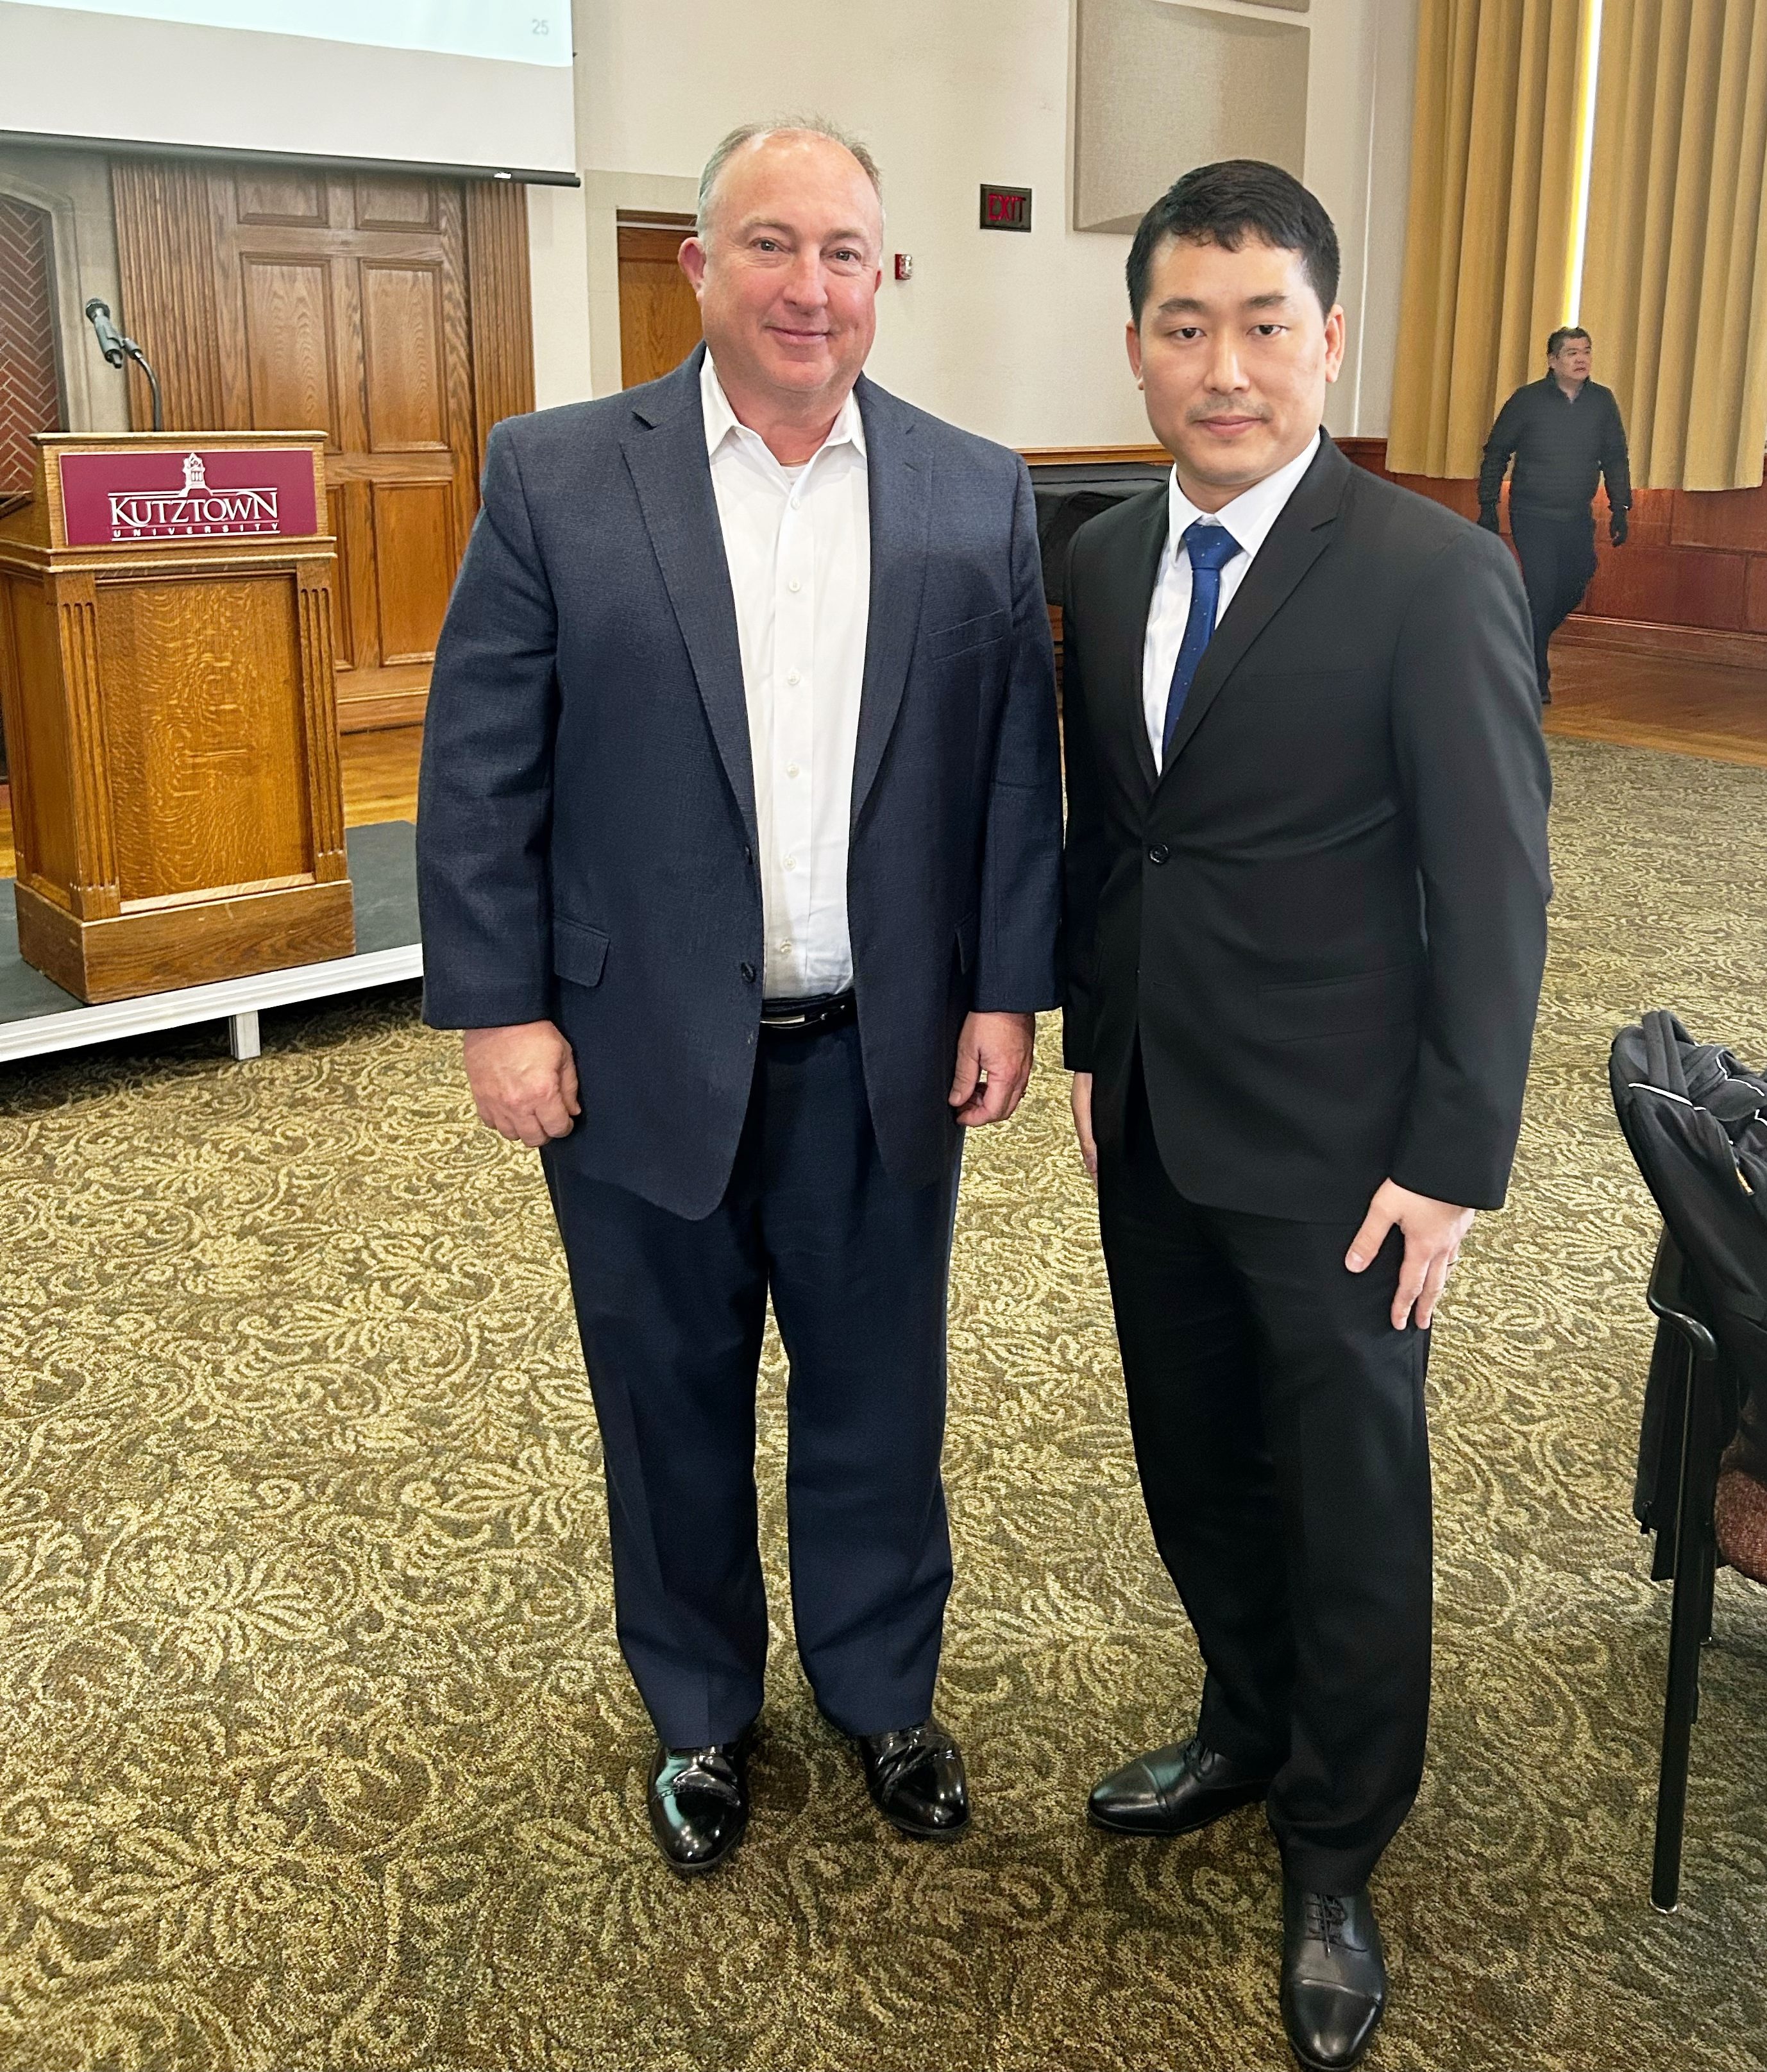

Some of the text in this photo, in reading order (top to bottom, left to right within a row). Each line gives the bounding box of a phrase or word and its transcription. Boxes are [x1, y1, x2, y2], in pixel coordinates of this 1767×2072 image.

[532, 19, 549, 35] 25
[988, 193, 1026, 222] EXIT
[110, 491, 278, 527] KUTZTOWN
[114, 523, 278, 538] UNIVERSITY
